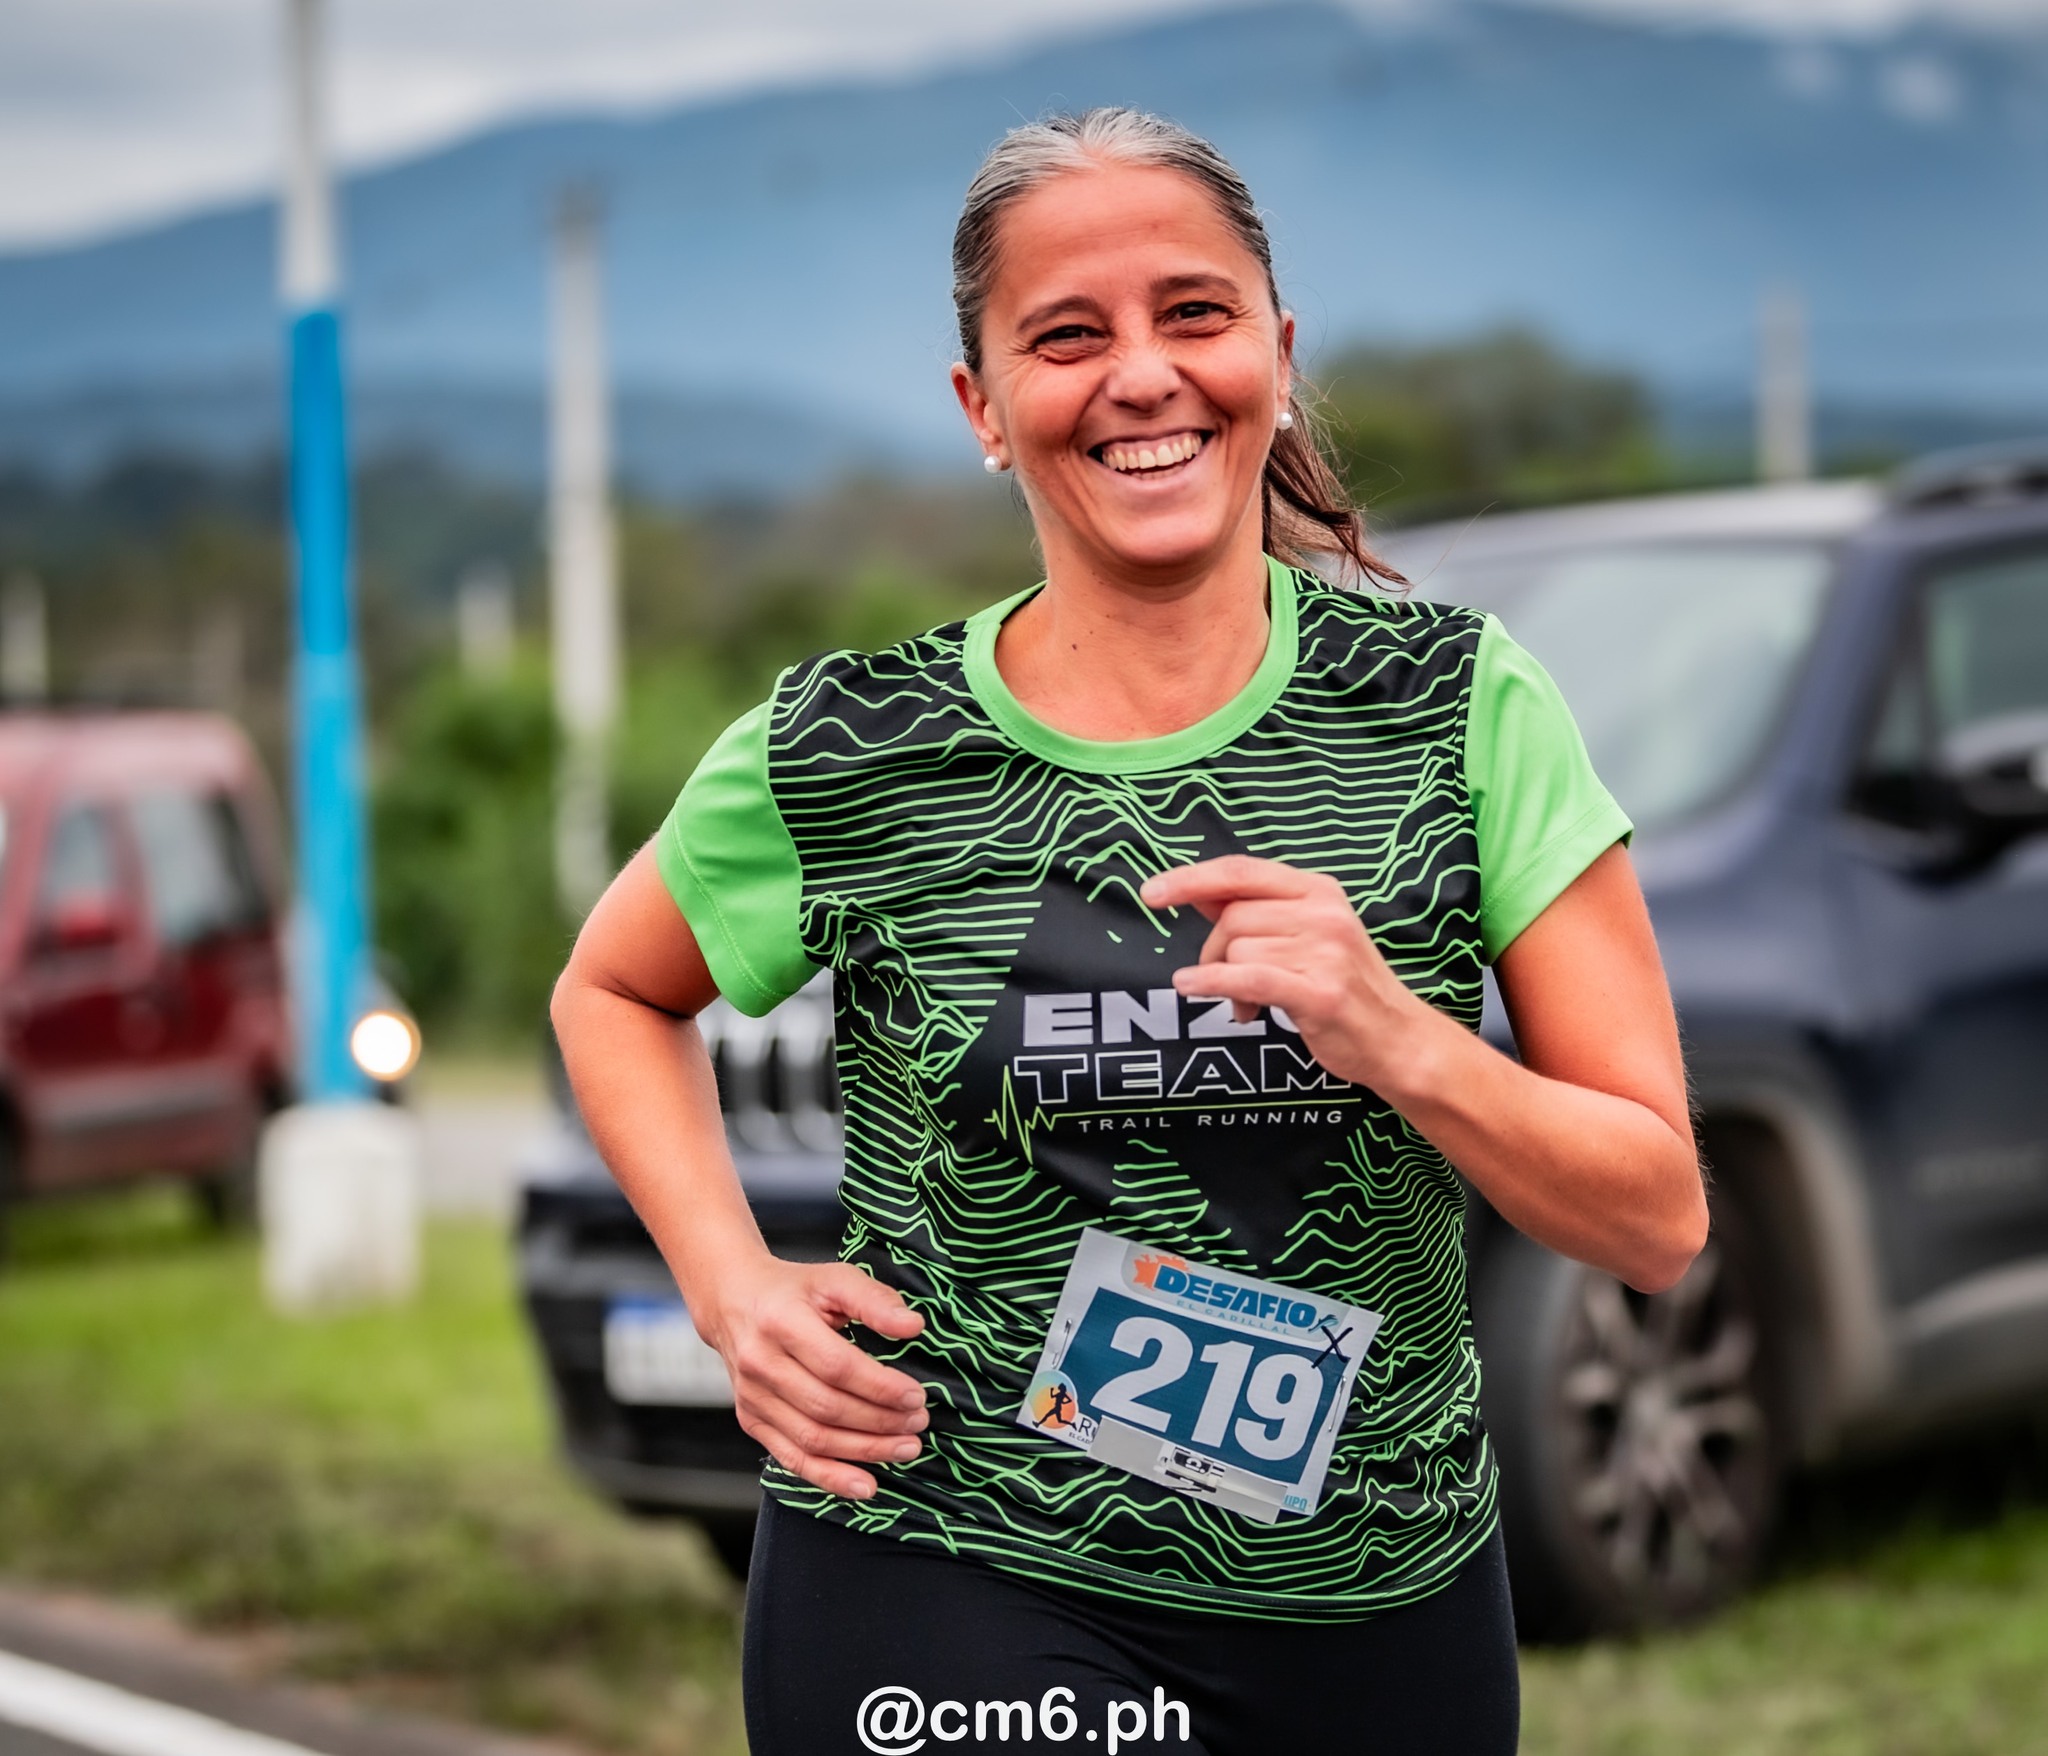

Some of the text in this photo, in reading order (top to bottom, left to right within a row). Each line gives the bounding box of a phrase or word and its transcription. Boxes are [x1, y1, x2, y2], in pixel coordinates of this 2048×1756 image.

[1023, 988, 1300, 1047] ENZ
[1013, 1044, 1352, 1104] TEAM
[1078, 1109, 1343, 1133] TRAIL RUNNING
[1153, 1264, 1317, 1329] DESAFIO
[1175, 1299, 1289, 1335] EL CADILLAL
[1090, 1315, 1325, 1461] 219
